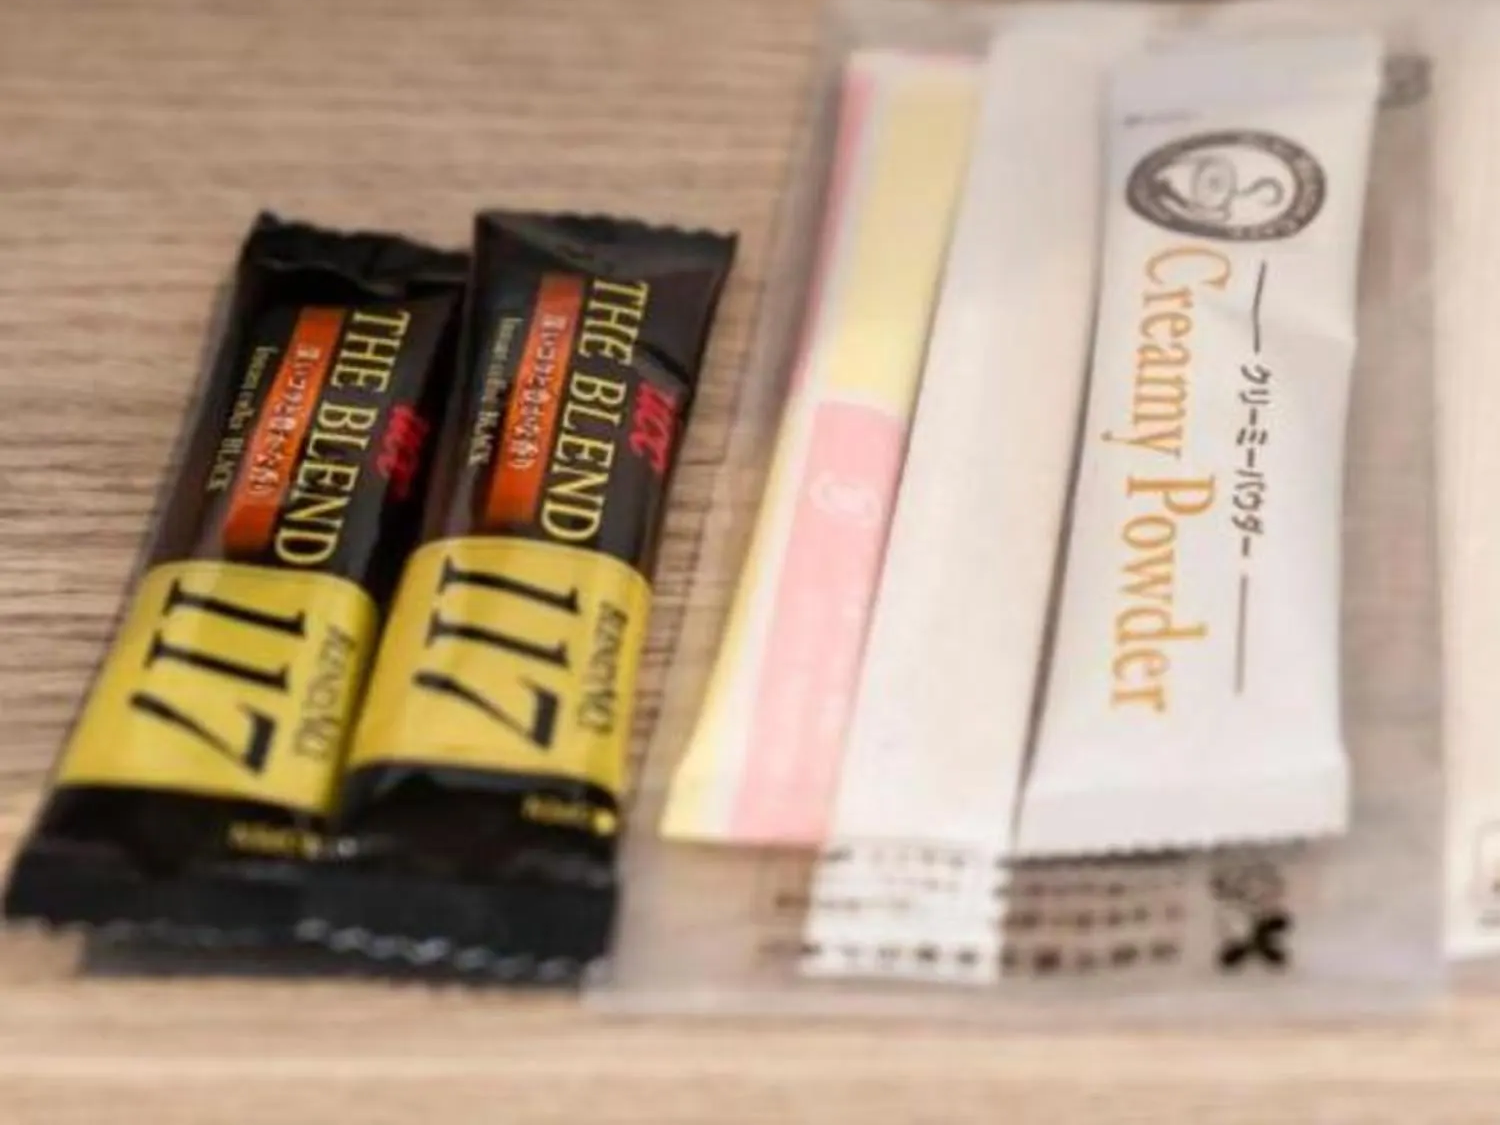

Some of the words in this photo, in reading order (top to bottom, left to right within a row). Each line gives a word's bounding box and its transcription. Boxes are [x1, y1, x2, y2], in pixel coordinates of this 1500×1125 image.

[330, 308, 411, 393] THE
[577, 276, 649, 365] THE
[1101, 246, 1232, 461] Creamy
[274, 399, 379, 565] BLEND
[540, 371, 627, 542] BLEND
[1231, 364, 1272, 557] クリーミーパウダー
[128, 577, 309, 775] 117
[409, 556, 583, 751] 117
[1111, 474, 1216, 712] Powder
